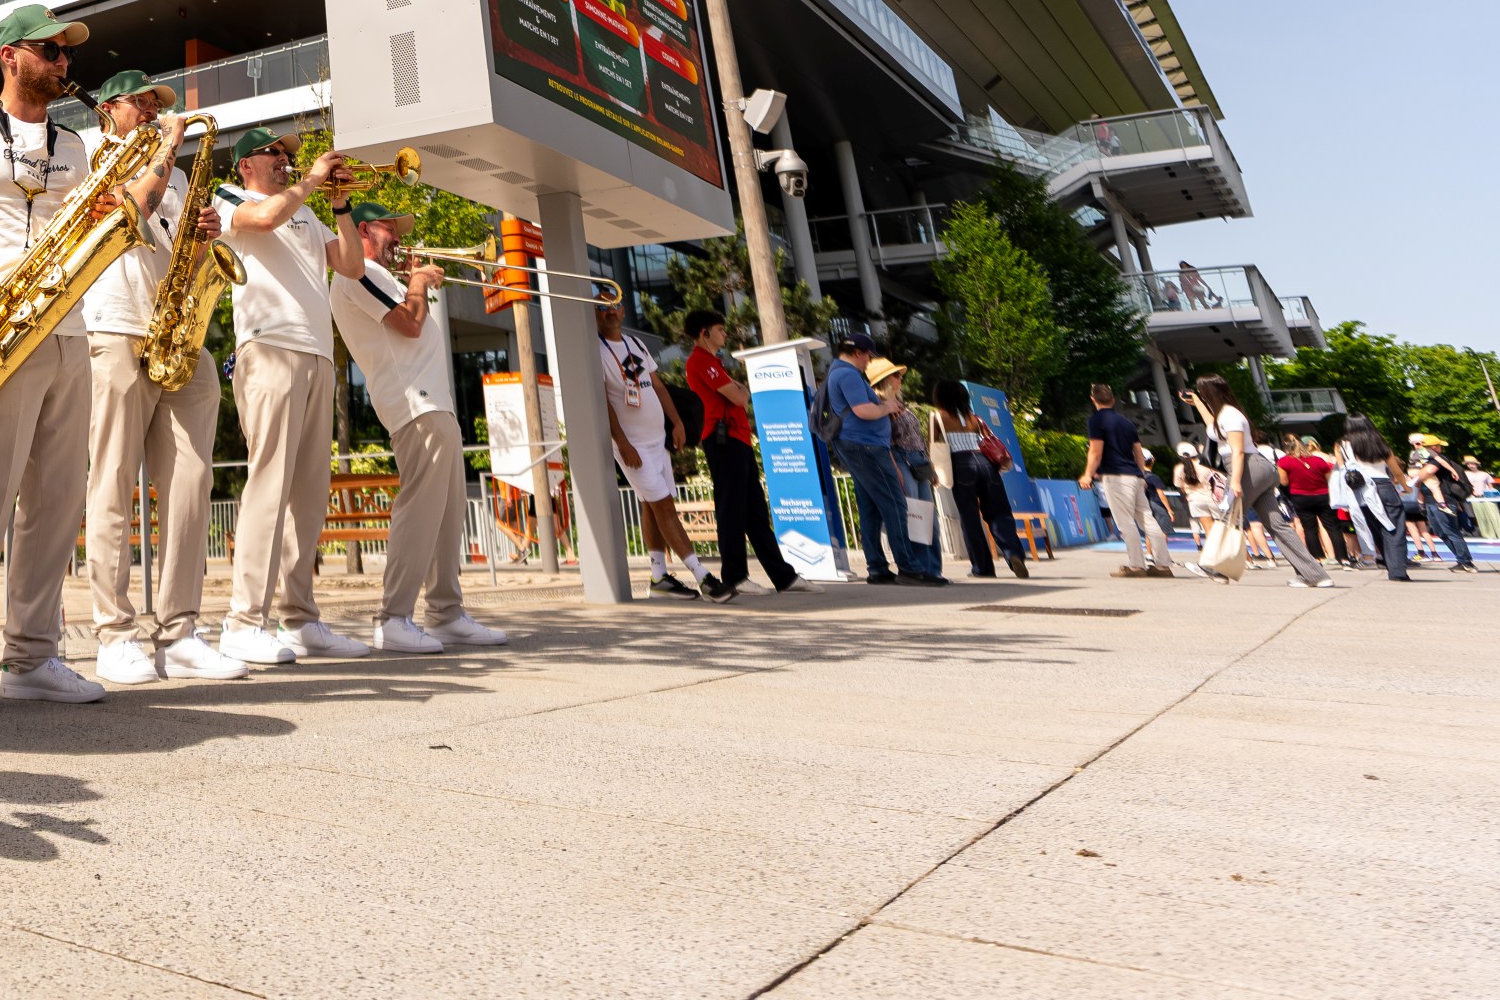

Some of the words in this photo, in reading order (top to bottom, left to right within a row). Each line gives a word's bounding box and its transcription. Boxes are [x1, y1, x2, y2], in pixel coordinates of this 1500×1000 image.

[584, 0, 629, 36] SIMONNE-MATHIEU
[642, 6, 658, 23] FRANCE
[519, 17, 540, 37] MATCHS
[539, 29, 547, 40] EN
[550, 35, 560, 48] SET
[595, 41, 630, 68] ENTRAÎNEMENTS
[661, 51, 675, 66] COURT
[598, 63, 616, 80] MATCHS
[624, 79, 632, 90] SET
[661, 81, 691, 105] ENTRAÎNEMENTS
[548, 78, 573, 98] RETROUVEZ
[579, 94, 605, 115] PROGRAMME
[605, 107, 623, 125] DÉTAILLÉ
[631, 122, 656, 142] L'APPLICATION
[656, 135, 685, 158] ROLAND-GARROS
[665, 103, 680, 118] MATCHS
[773, 507, 790, 515] votre
[791, 507, 823, 516] téléphone
[780, 498, 813, 508] Rechargez
